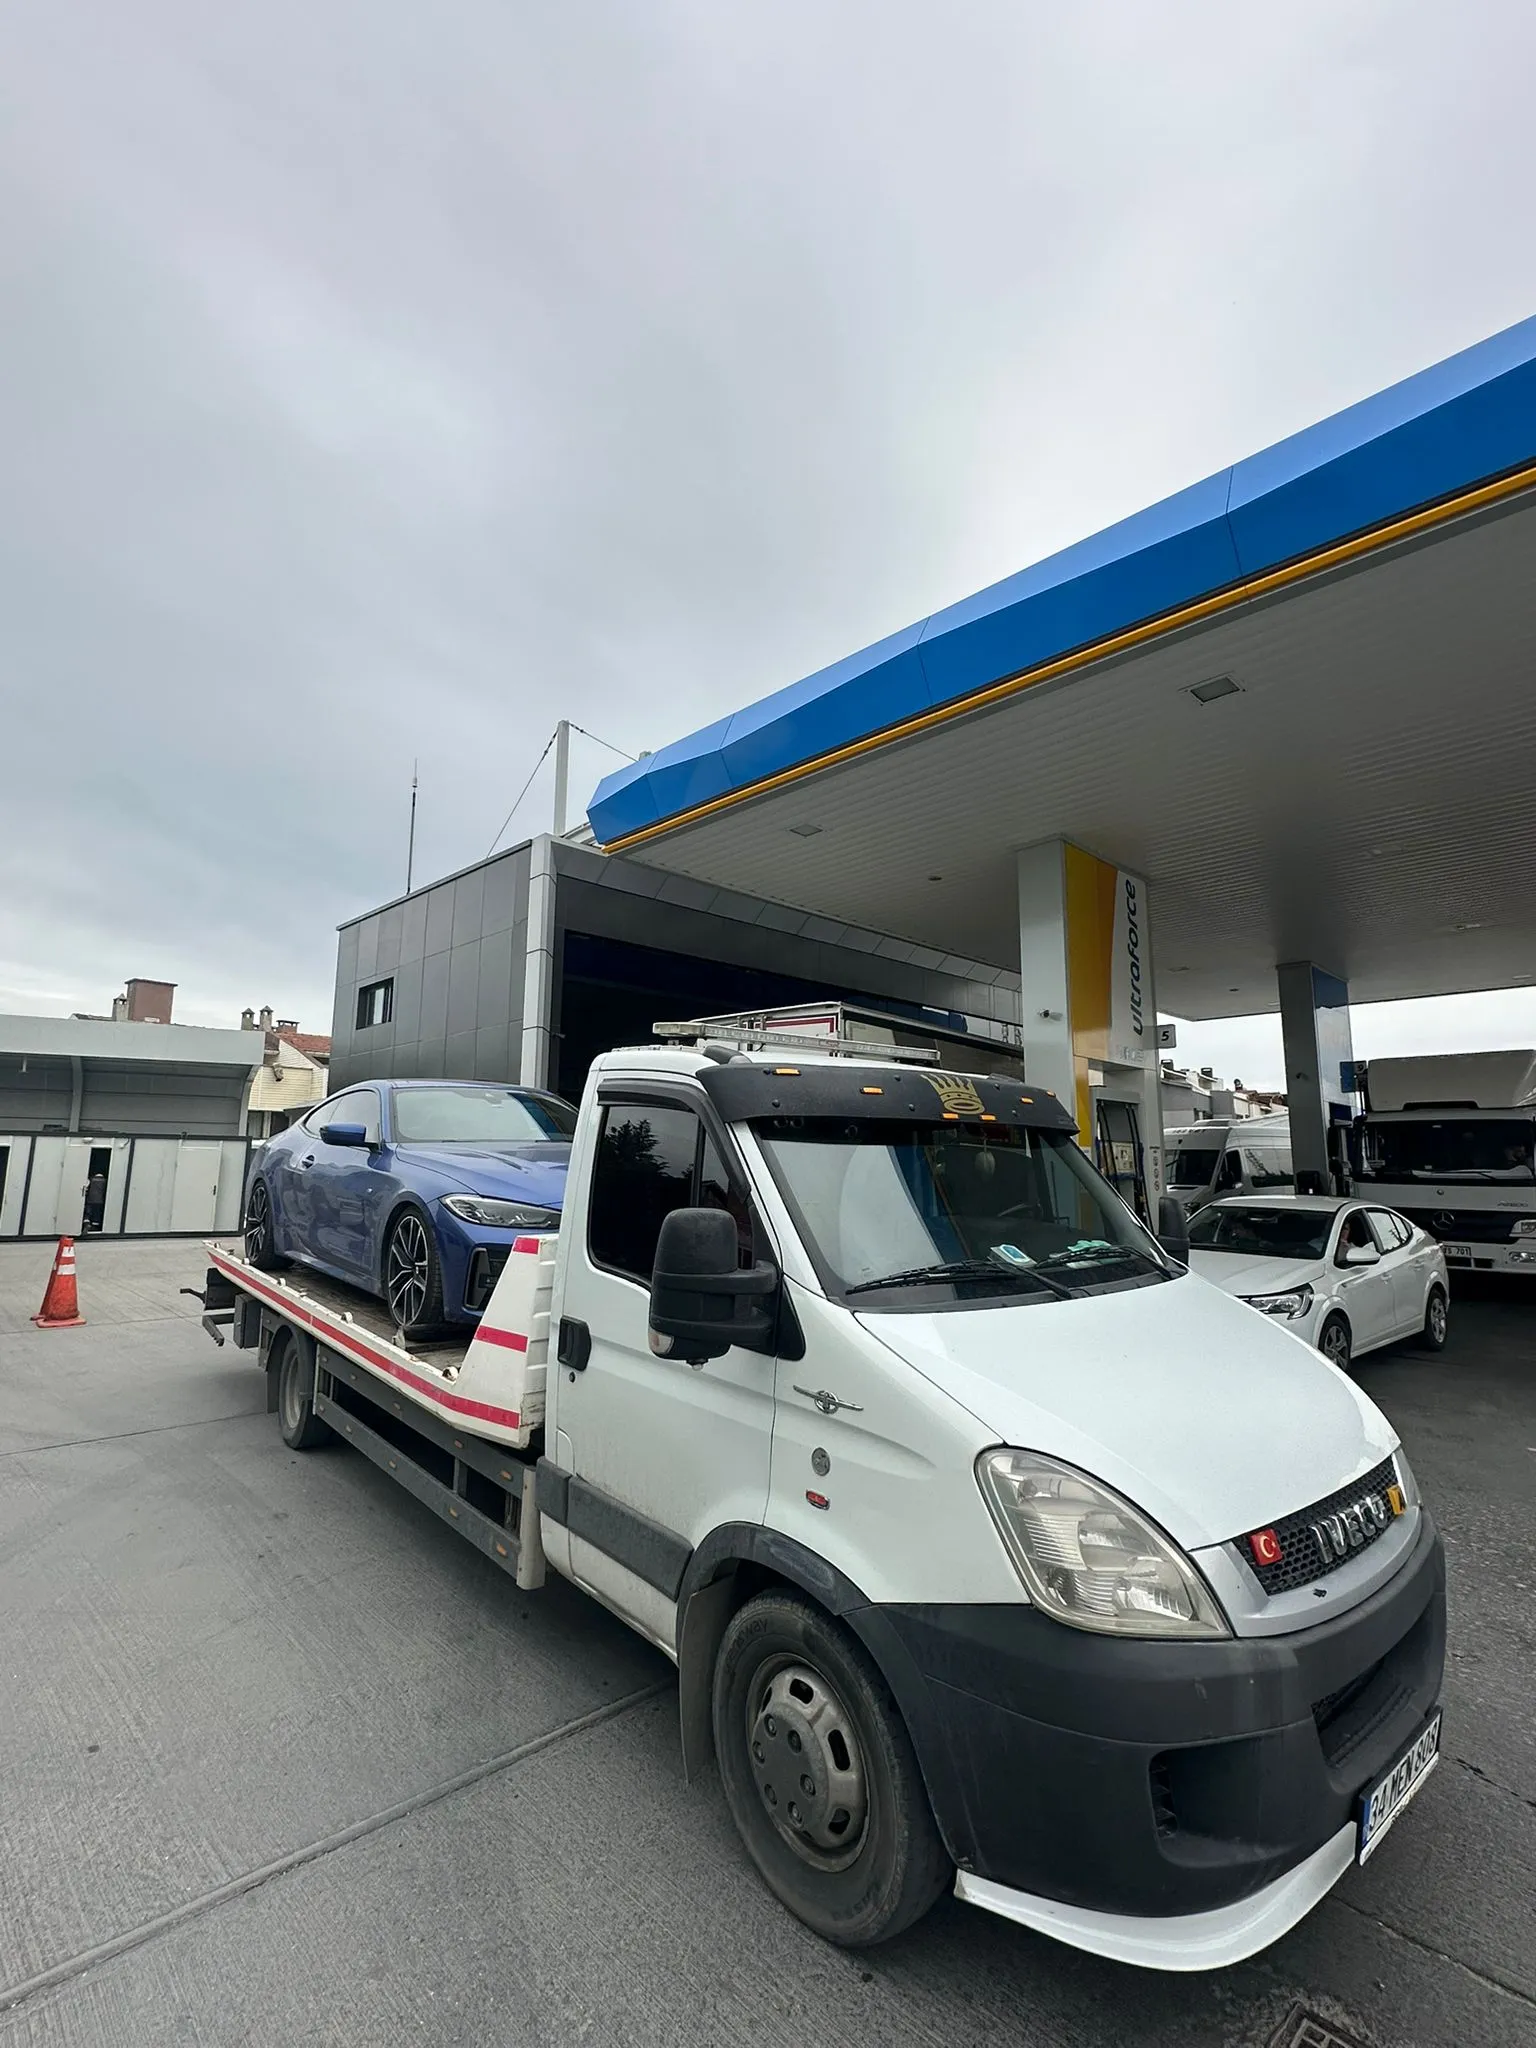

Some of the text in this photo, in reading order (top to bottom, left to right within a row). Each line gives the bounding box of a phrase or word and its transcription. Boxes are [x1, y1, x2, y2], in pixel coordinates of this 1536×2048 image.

[1126, 879, 1143, 1036] ultraforce
[1161, 1030, 1170, 1042] 5
[1308, 1493, 1388, 1564] IVECO
[1370, 1783, 1388, 1832] 34
[1389, 1750, 1415, 1809] MEN
